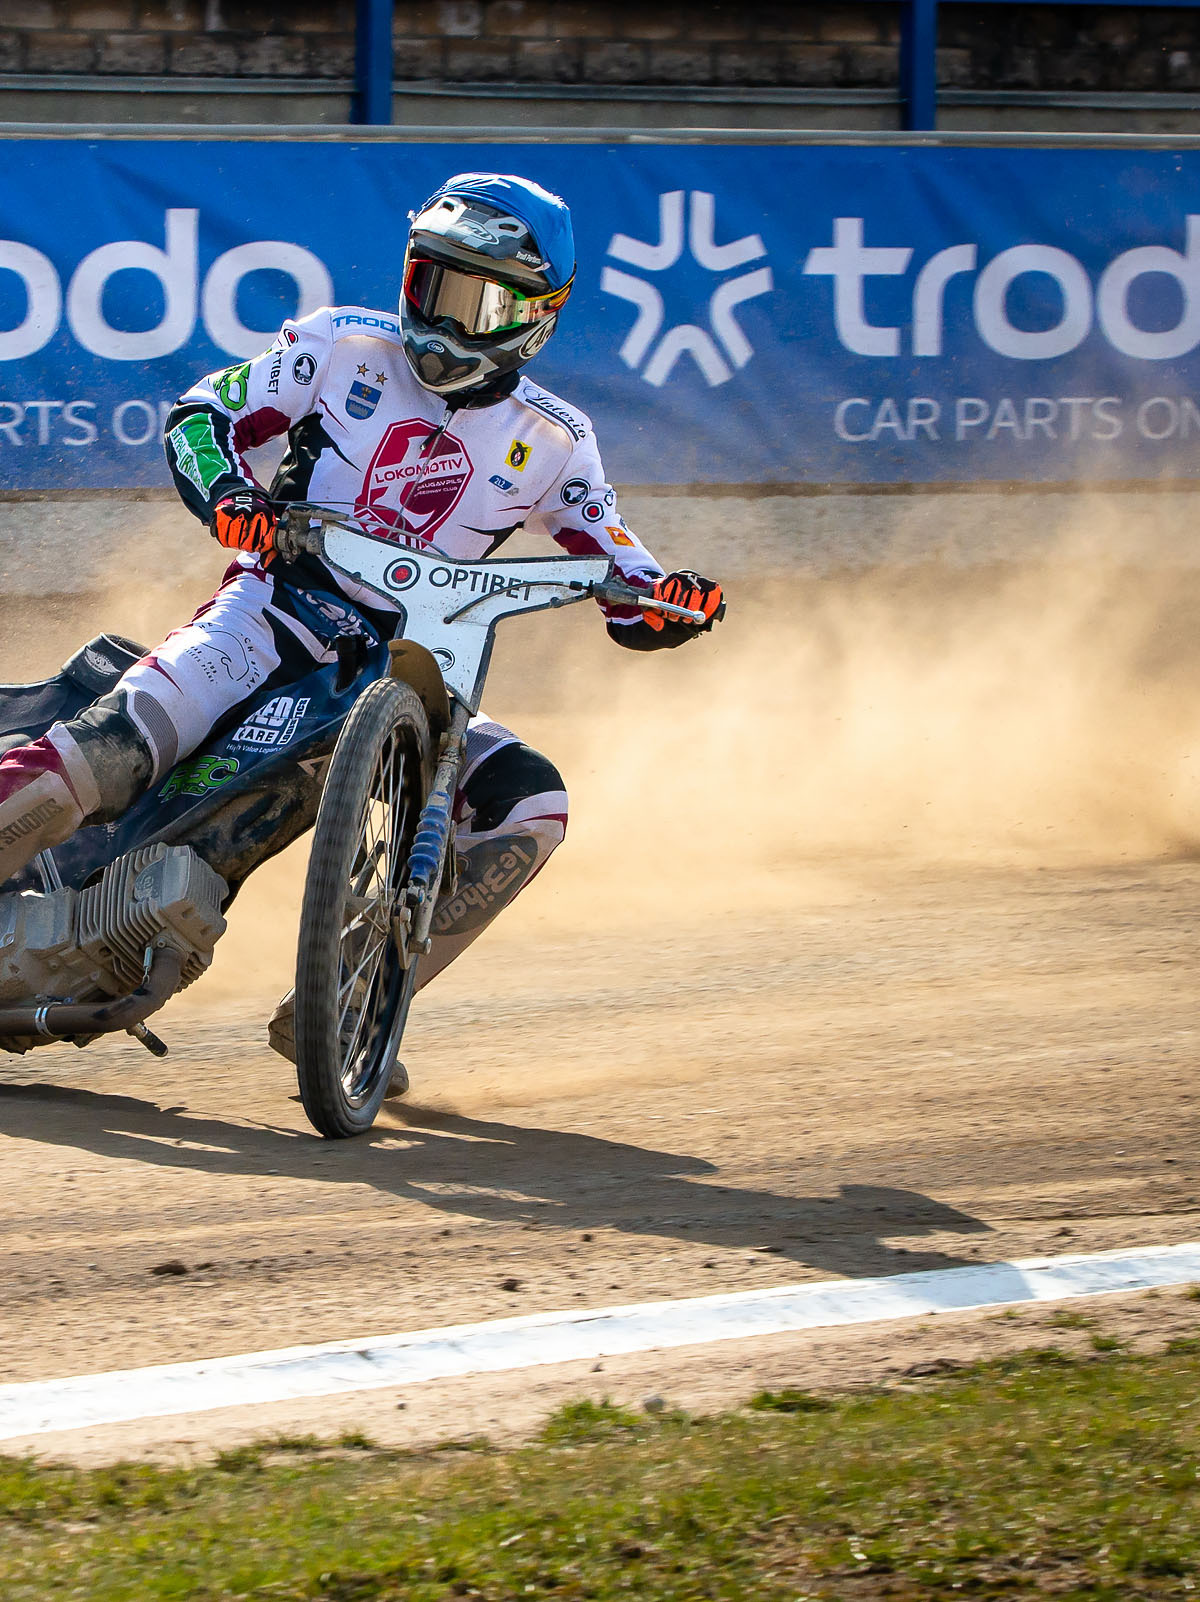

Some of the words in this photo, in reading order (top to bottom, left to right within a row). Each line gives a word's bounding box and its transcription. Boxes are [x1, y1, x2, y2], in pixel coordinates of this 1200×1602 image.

[803, 215, 1200, 360] trod
[523, 385, 586, 439] Interio
[834, 398, 941, 442] CAR
[957, 397, 1123, 441] PARTS
[375, 457, 463, 484] LOKOMOTIV
[235, 492, 253, 513] OX
[429, 566, 531, 601] OPTIBET
